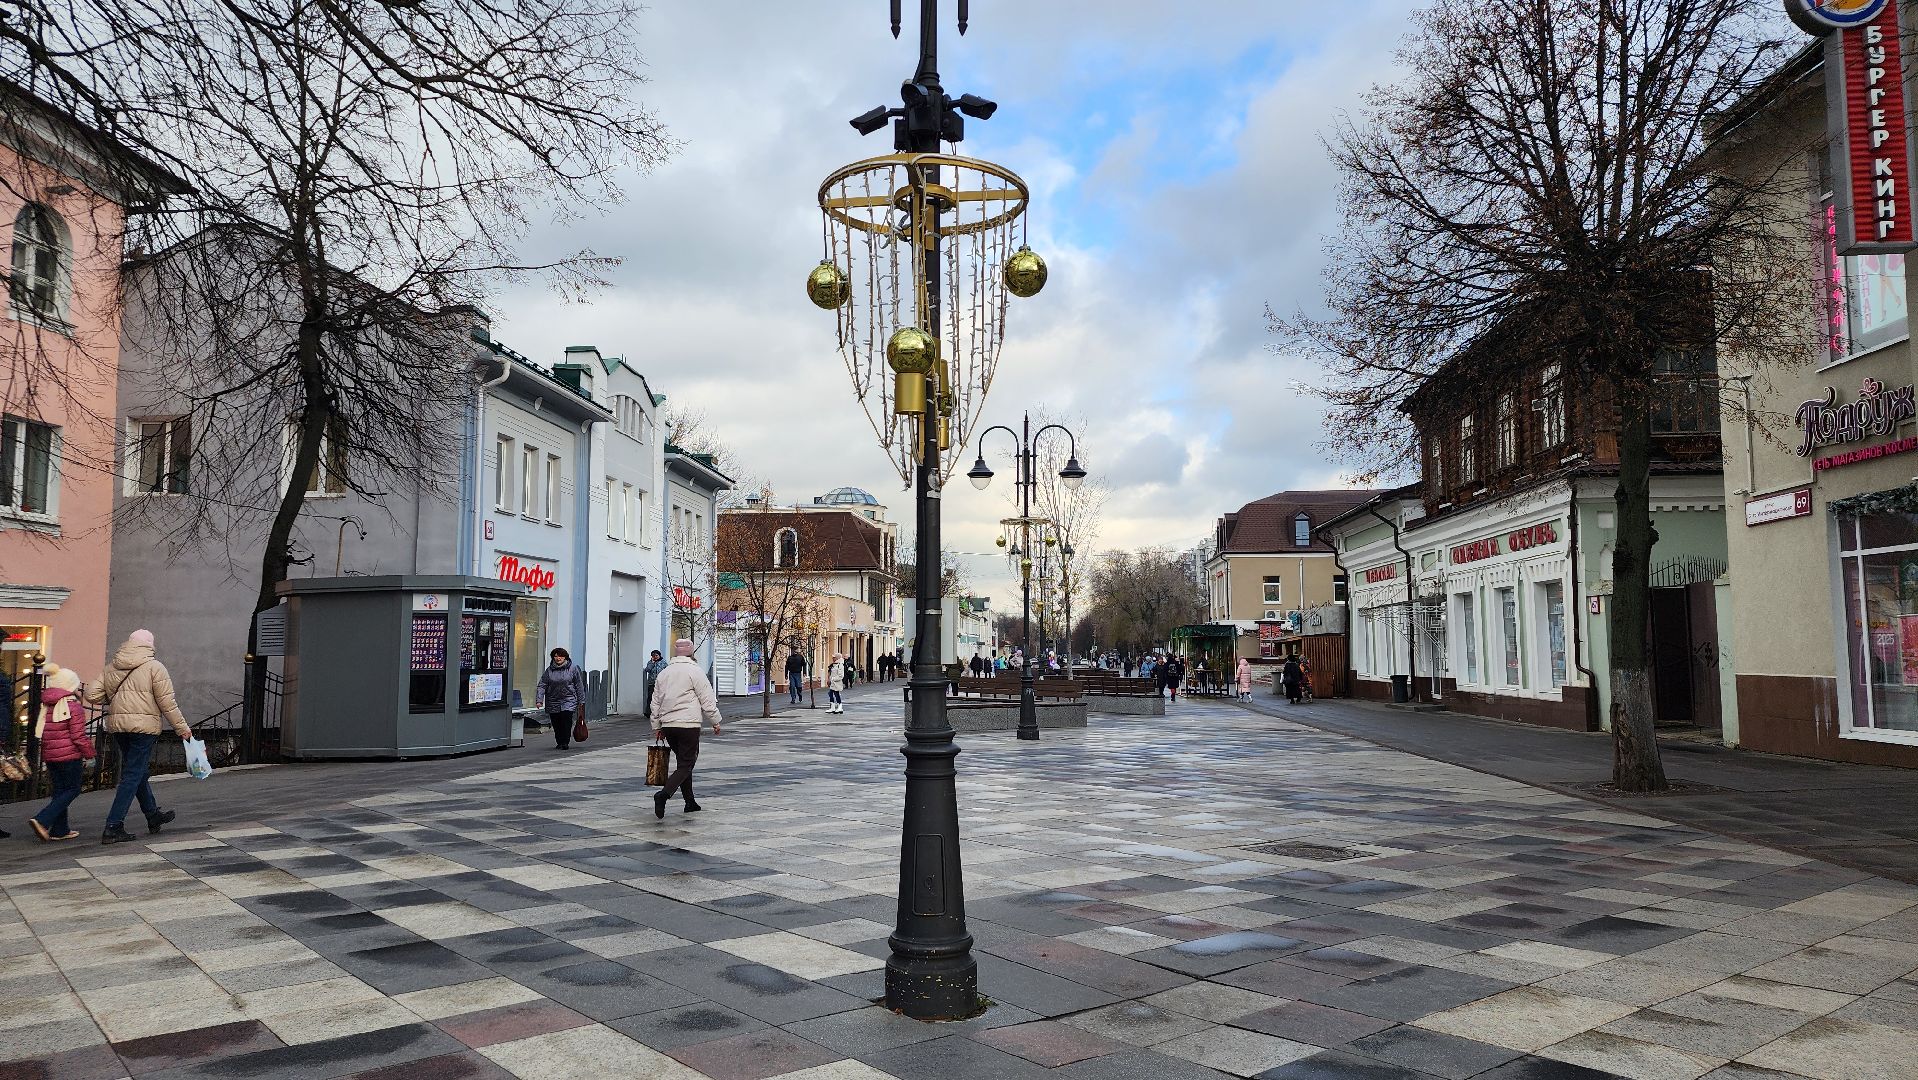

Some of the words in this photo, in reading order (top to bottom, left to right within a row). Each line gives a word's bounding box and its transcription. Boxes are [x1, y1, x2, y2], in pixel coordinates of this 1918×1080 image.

[1866, 25, 1889, 148] БУРГЕР
[1875, 157, 1896, 239] КИНГ
[1832, 446, 1882, 467] МАГАЗИНОВ
[1796, 496, 1807, 509] 69
[1508, 524, 1556, 552] ОБУВЬ
